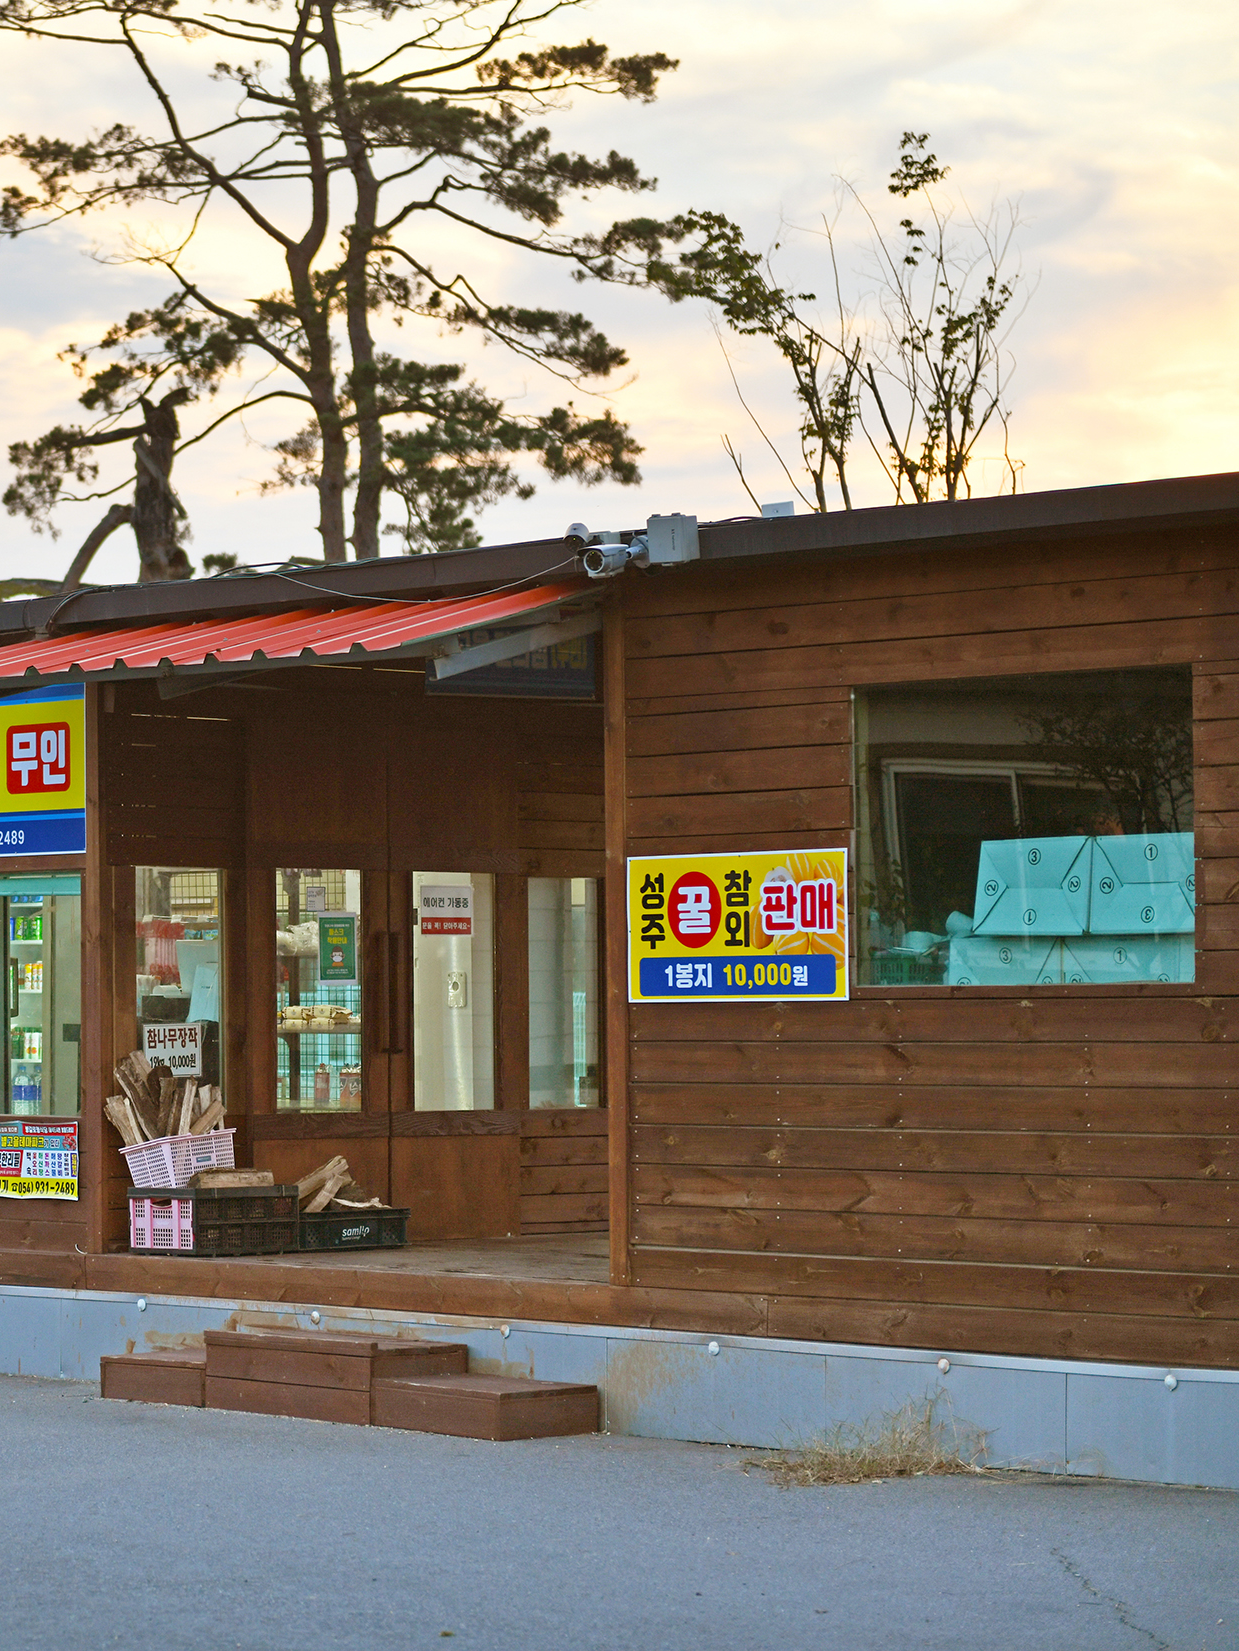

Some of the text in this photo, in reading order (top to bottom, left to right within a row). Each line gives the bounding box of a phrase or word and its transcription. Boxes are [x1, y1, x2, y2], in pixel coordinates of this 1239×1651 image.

[11, 729, 66, 786] 무인
[423, 897, 469, 908] 에어컨 가동중
[640, 870, 835, 950] 성주 꿀 참외 판매
[664, 963, 808, 989] 1봉지 10,000원
[147, 1027, 198, 1049] 참나무장작
[168, 1053, 196, 1070] 10,000원
